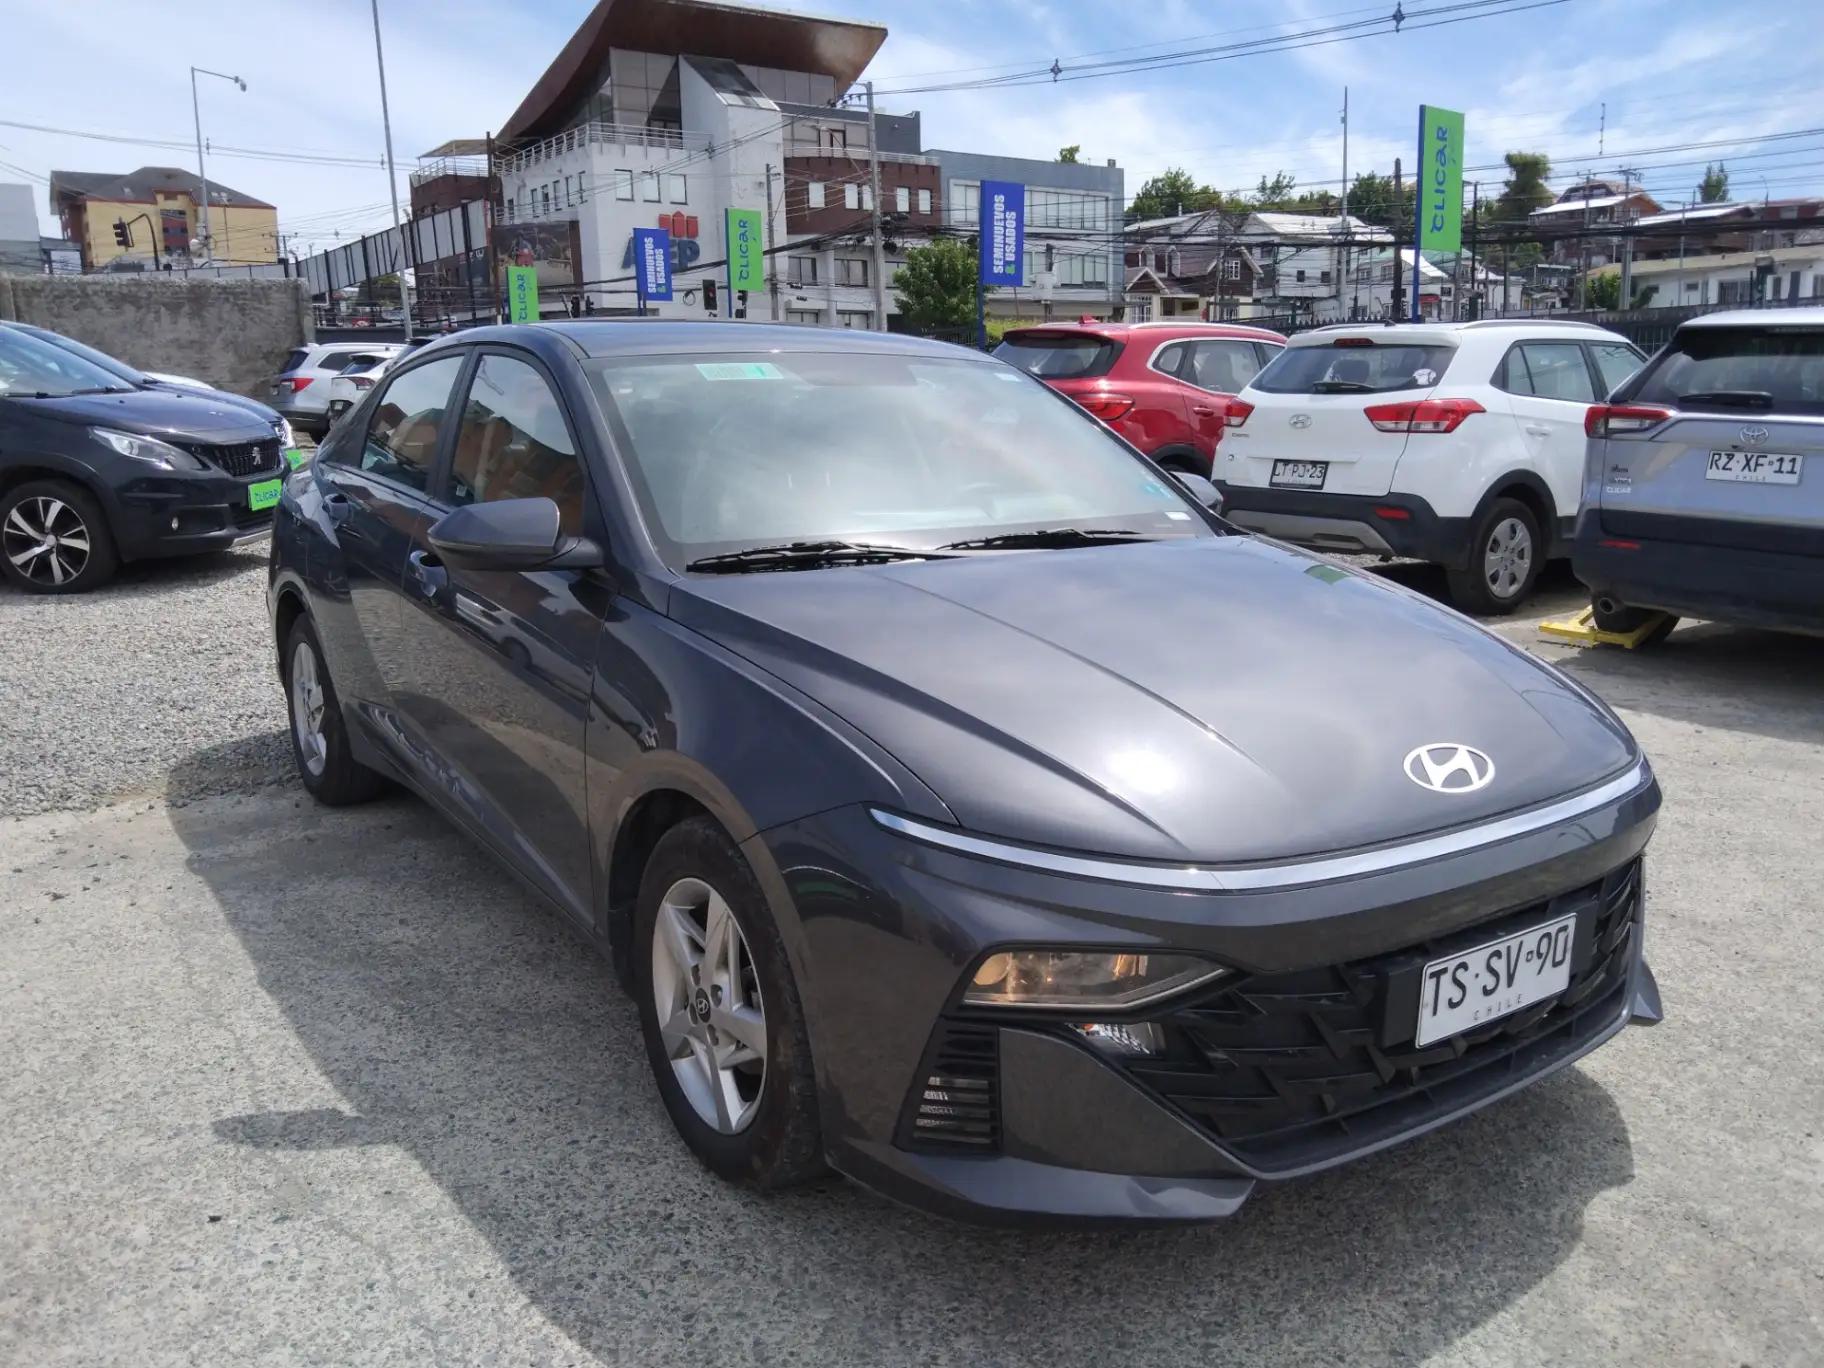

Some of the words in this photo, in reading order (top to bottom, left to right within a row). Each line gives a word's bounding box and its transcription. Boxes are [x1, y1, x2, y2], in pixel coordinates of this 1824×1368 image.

[993, 194, 1005, 274] SEMINUEVOS
[1005, 211, 1016, 261] USADOS
[644, 237, 656, 293] SEMINUEVOS
[655, 248, 665, 284] USADOS
